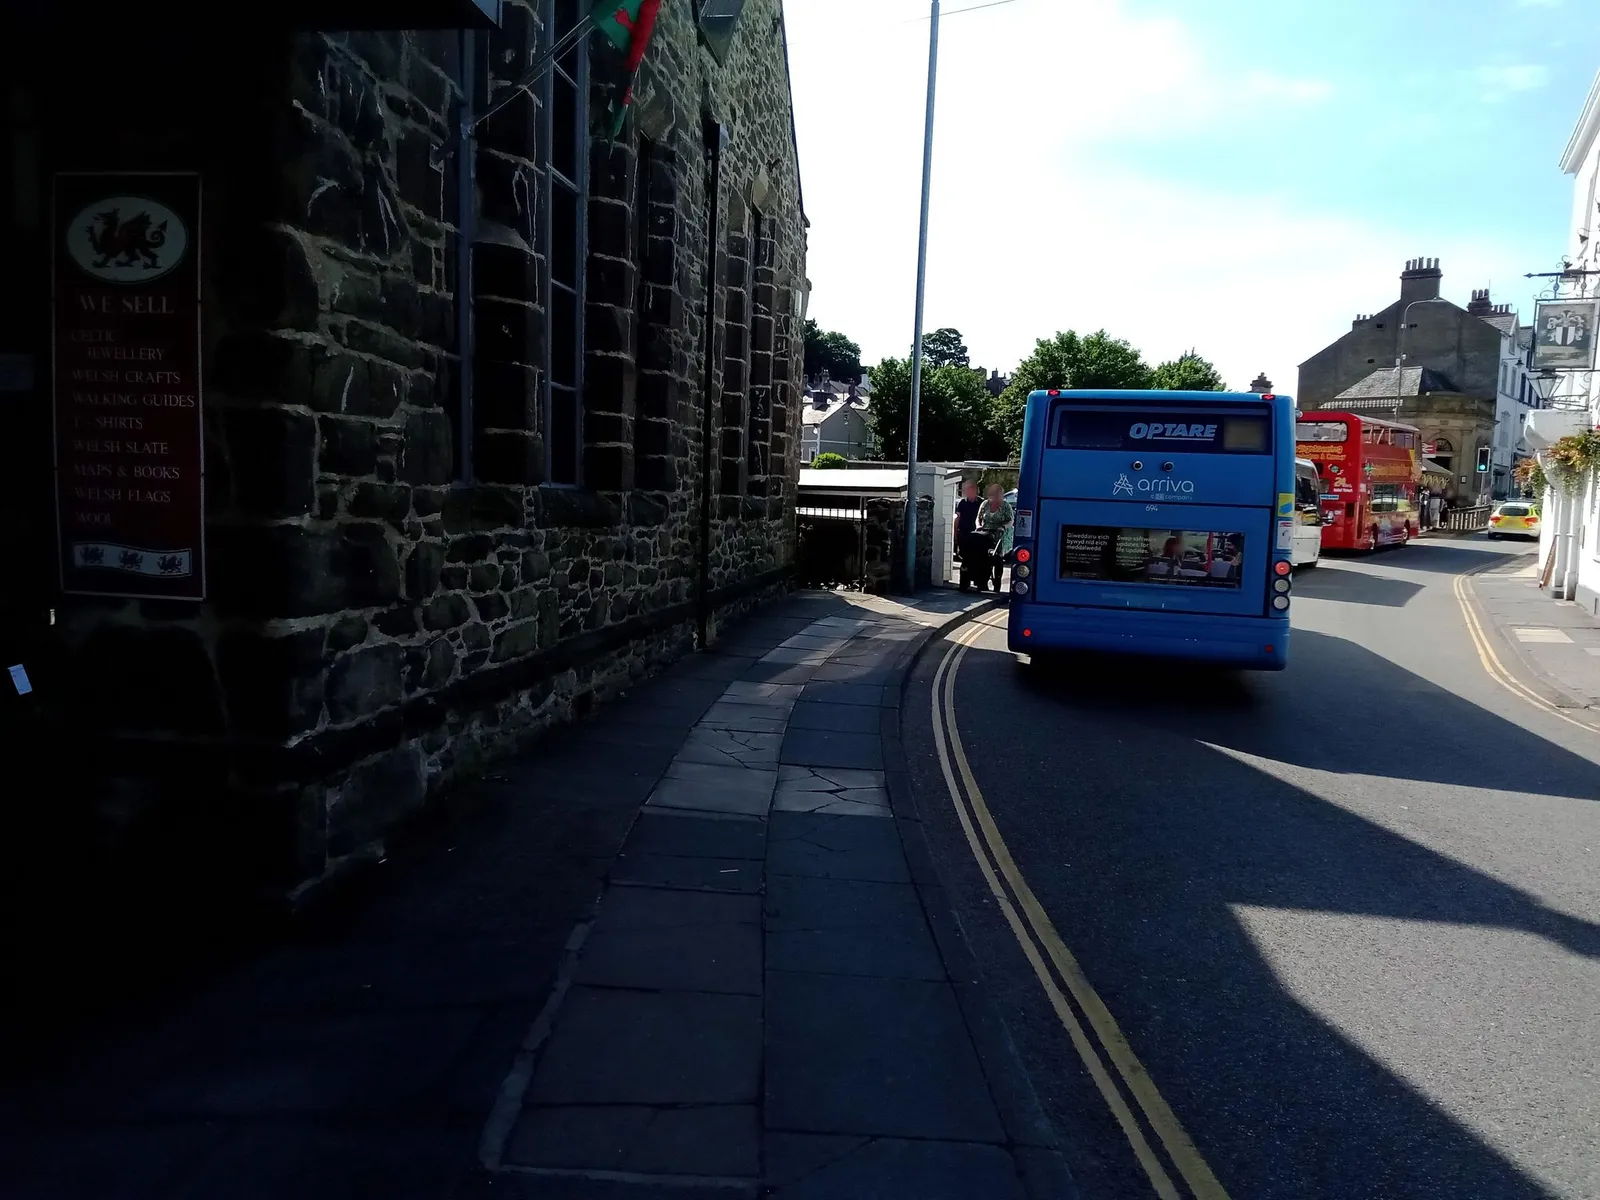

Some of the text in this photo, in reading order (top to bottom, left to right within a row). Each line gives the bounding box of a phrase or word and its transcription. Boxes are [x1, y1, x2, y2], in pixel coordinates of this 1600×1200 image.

[80, 294, 175, 314] WE SELL
[70, 329, 118, 342] CELTIC
[87, 346, 164, 361] JEWELLERY
[72, 368, 181, 385] WELSH CRAFTS
[73, 391, 195, 408] WALKING GUIDES
[95, 415, 144, 431] SHIRTS
[1129, 422, 1218, 440] OPTARE
[73, 438, 169, 455] WELSH SLATE
[73, 462, 181, 480] MAPS & BOOKS
[1137, 476, 1194, 493] arriva
[74, 486, 171, 504] WELSH FLAGS
[76, 510, 114, 525] WOOL
